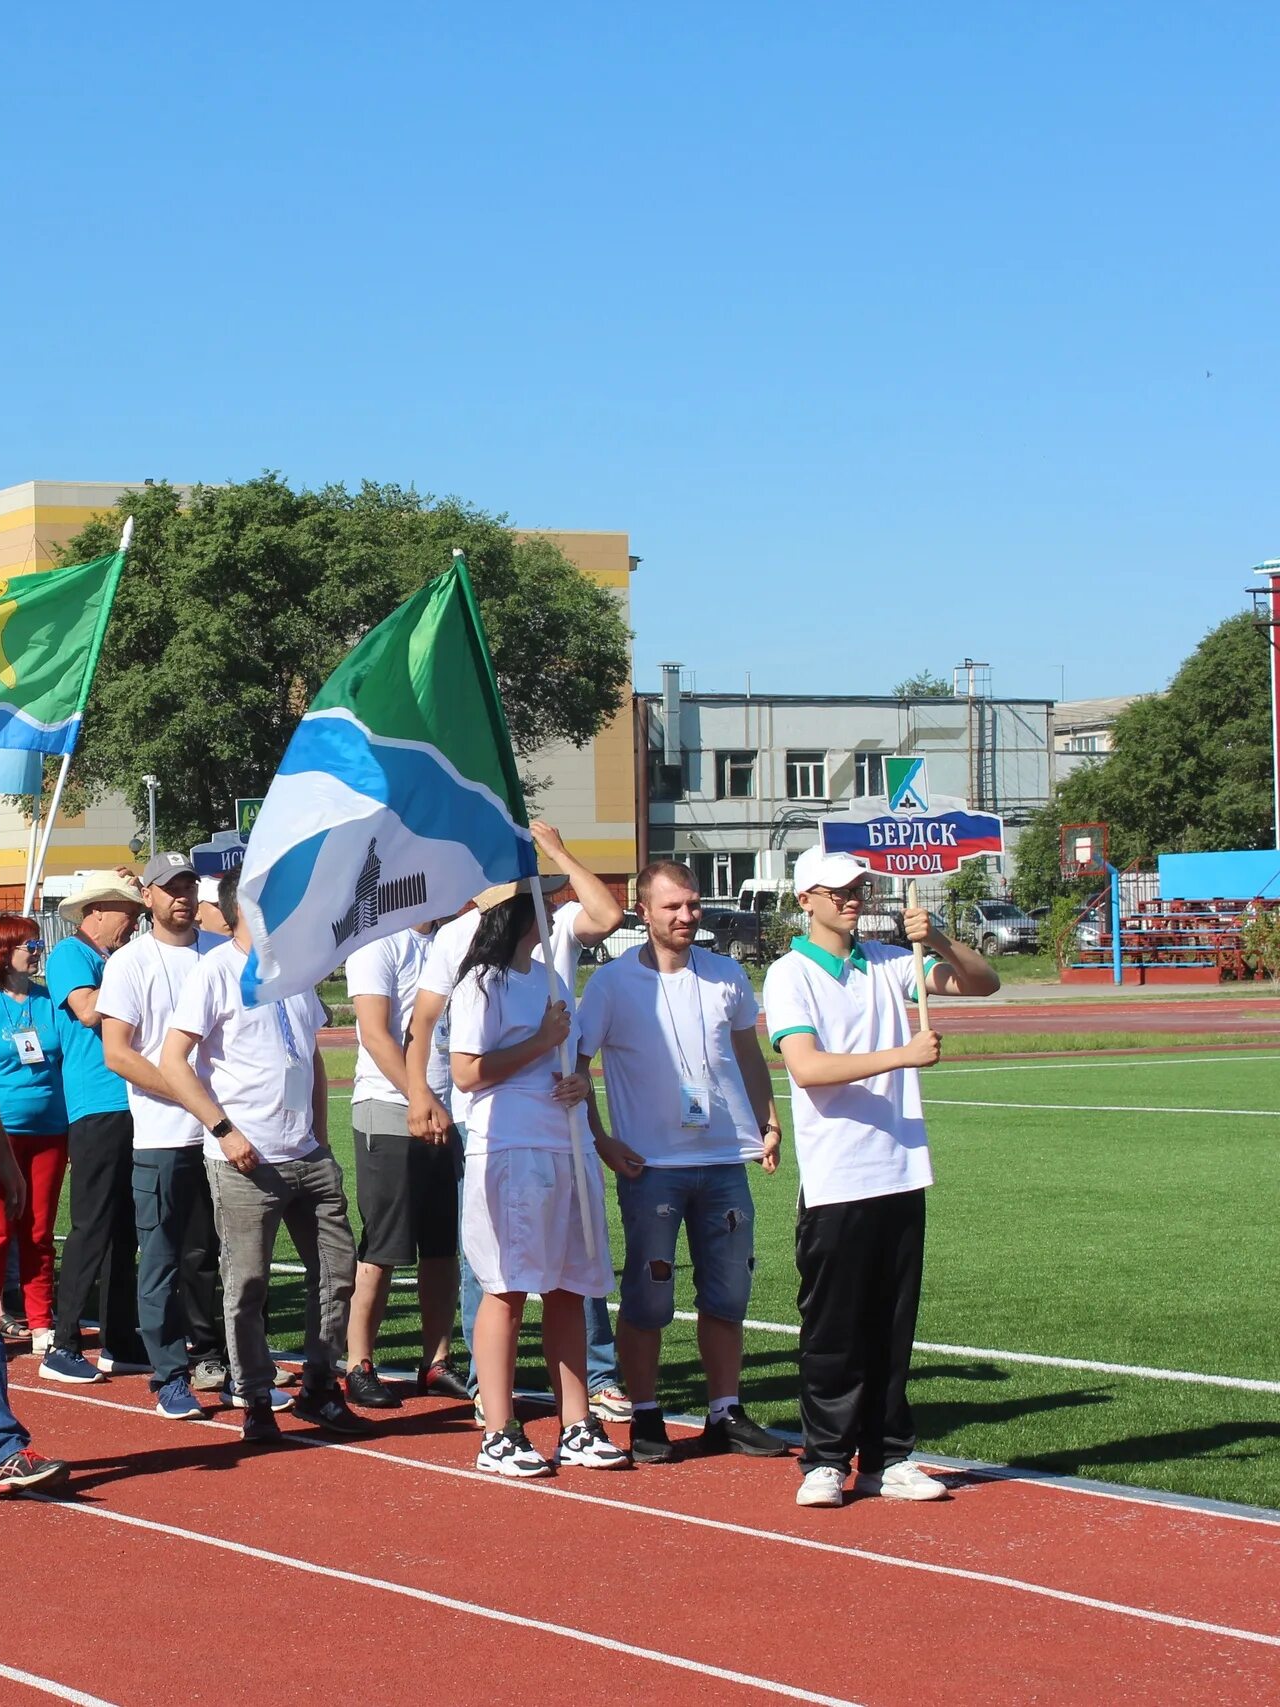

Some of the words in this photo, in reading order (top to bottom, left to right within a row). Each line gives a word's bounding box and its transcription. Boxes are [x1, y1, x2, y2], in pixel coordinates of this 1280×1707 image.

[867, 823, 958, 851] БЕРДСК
[221, 851, 244, 870] ИС
[886, 854, 943, 873] ГОРОД
